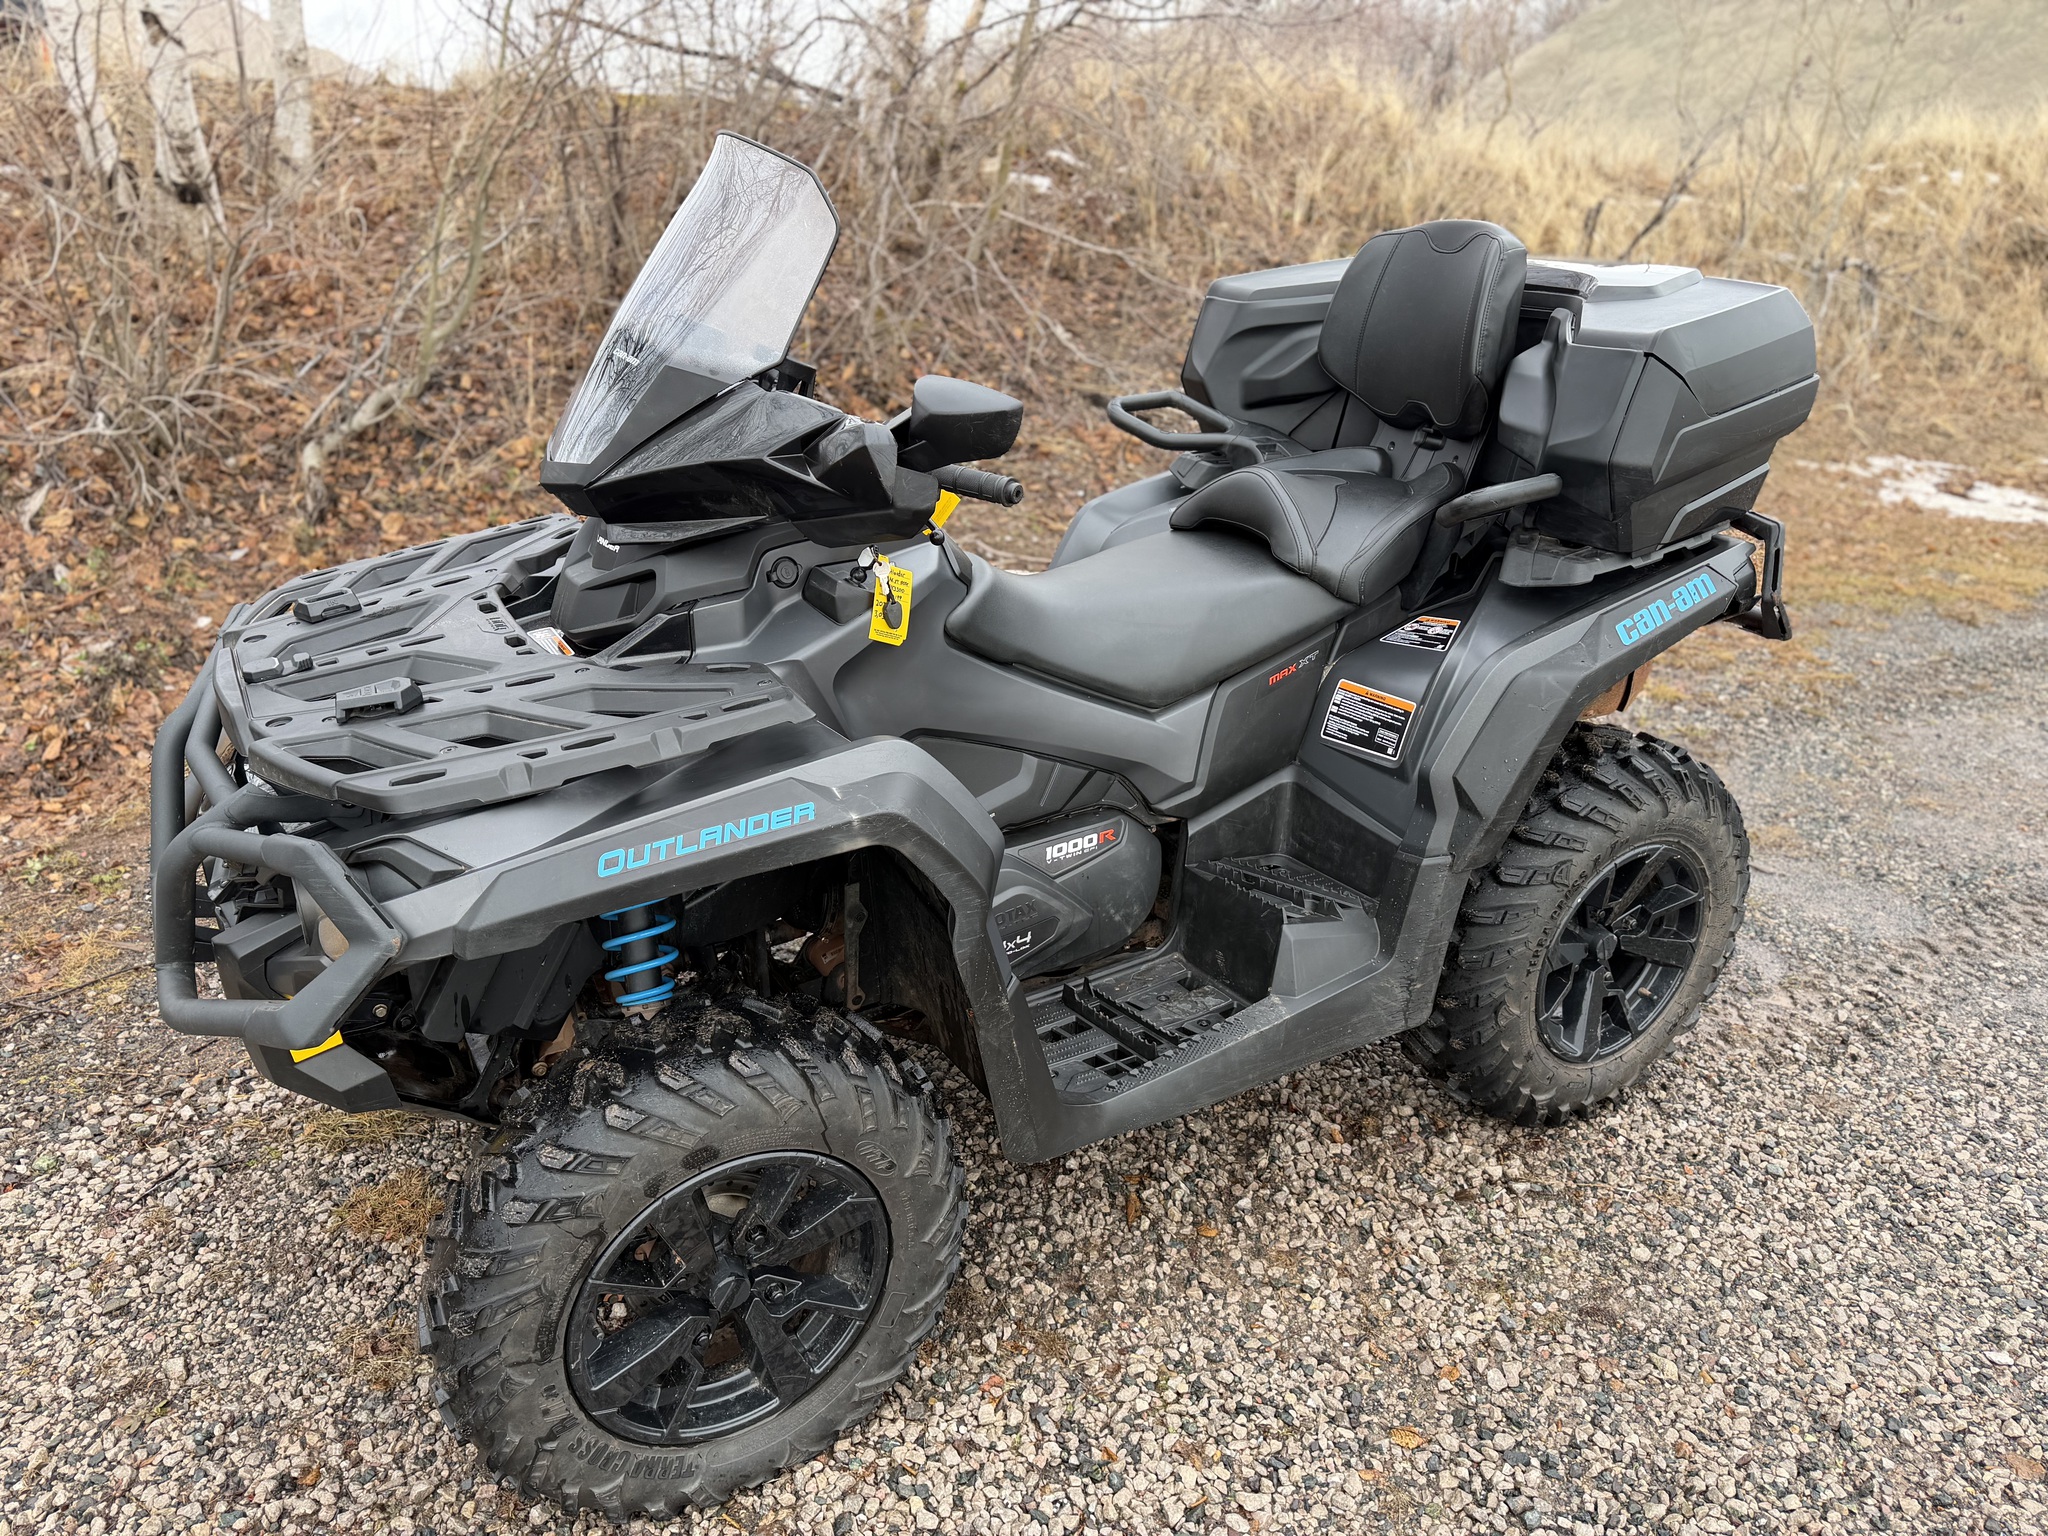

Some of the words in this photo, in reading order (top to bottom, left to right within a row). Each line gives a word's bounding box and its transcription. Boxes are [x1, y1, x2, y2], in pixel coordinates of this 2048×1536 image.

[613, 348, 640, 366] can-am
[1615, 573, 1717, 646] can-am
[1269, 664, 1297, 686] MAX
[1298, 650, 1319, 669] XT
[597, 801, 815, 878] OUTLANDER
[567, 1435, 632, 1475] CROSS
[630, 1454, 696, 1480] TERRA
